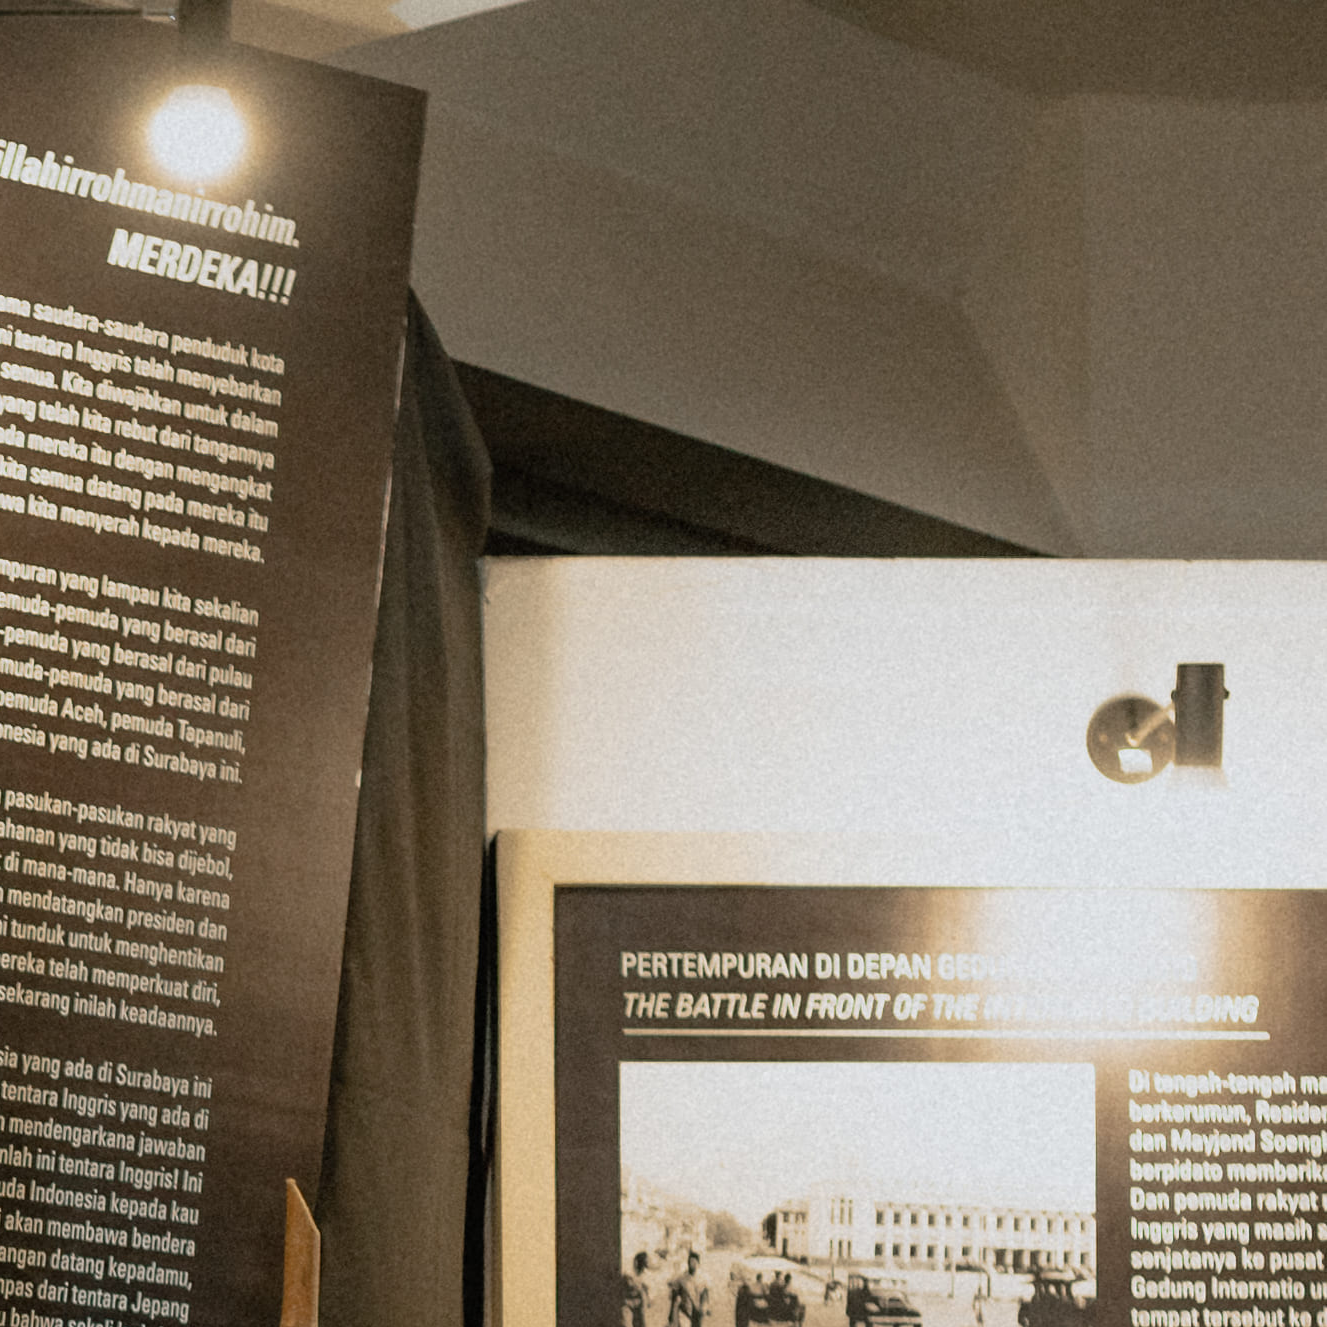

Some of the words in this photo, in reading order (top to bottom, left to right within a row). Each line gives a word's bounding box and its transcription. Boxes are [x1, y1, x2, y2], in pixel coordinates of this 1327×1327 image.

[106, 228, 297, 305] MERDEKA!!!
[621, 951, 808, 979] PERTEMPURAN
[815, 952, 841, 979] DI
[847, 952, 932, 981] DEPAN
[73, 991, 117, 1020] inilah
[119, 999, 218, 1038] keadaannya.
[623, 992, 672, 1019] THE
[675, 992, 769, 1019] BATTLE
[772, 992, 802, 1019] IN
[805, 992, 891, 1020] FRONT
[893, 992, 928, 1021] OF
[930, 990, 977, 1022] THE
